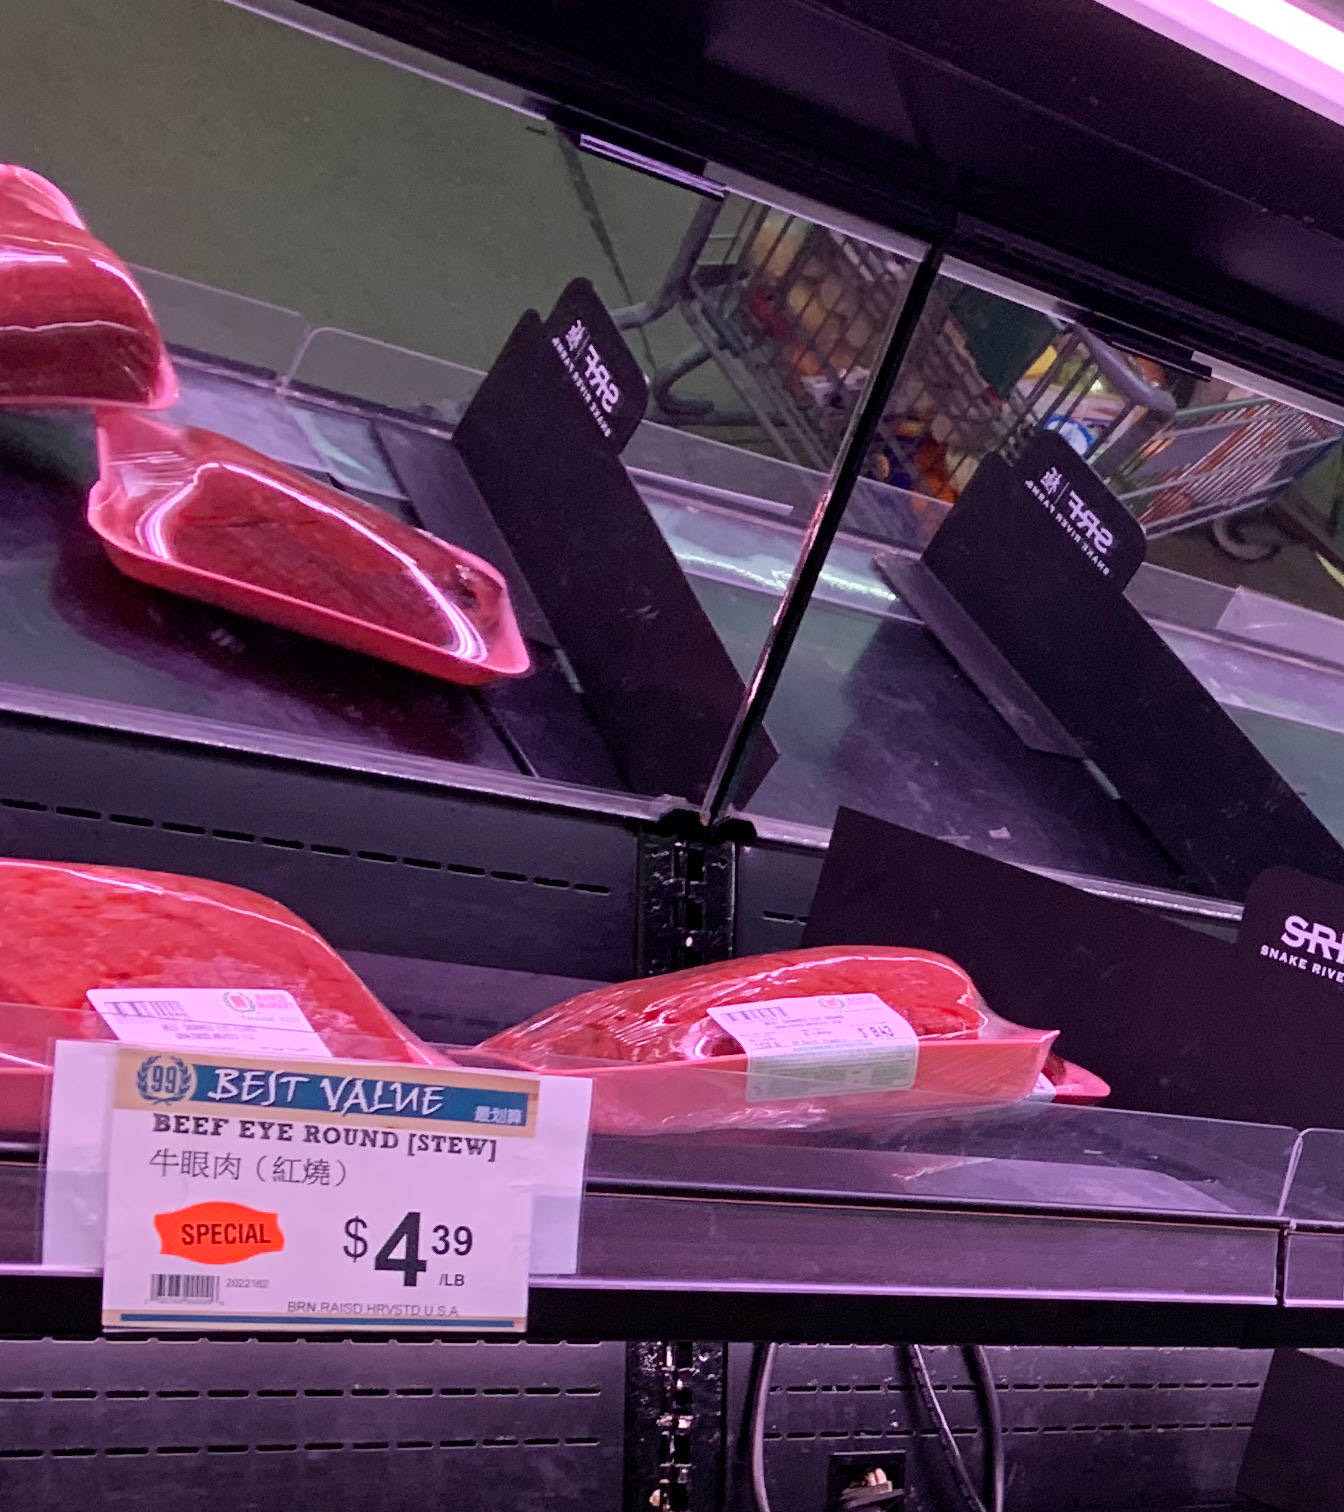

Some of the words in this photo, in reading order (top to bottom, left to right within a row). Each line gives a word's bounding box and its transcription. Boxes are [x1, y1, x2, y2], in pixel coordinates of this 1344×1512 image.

[1260, 945, 1307, 970] SNAKE
[149, 1071, 178, 1094] 99
[208, 1067, 309, 1107] BEST
[320, 1076, 446, 1117] VALUE
[152, 1113, 229, 1137] BEEF
[239, 1119, 298, 1142] EYE
[302, 1125, 399, 1150] ROUND
[407, 1132, 498, 1163] [STEW]
[181, 1222, 272, 1246] SPECIAL
[438, 1274, 465, 1287] /LB
